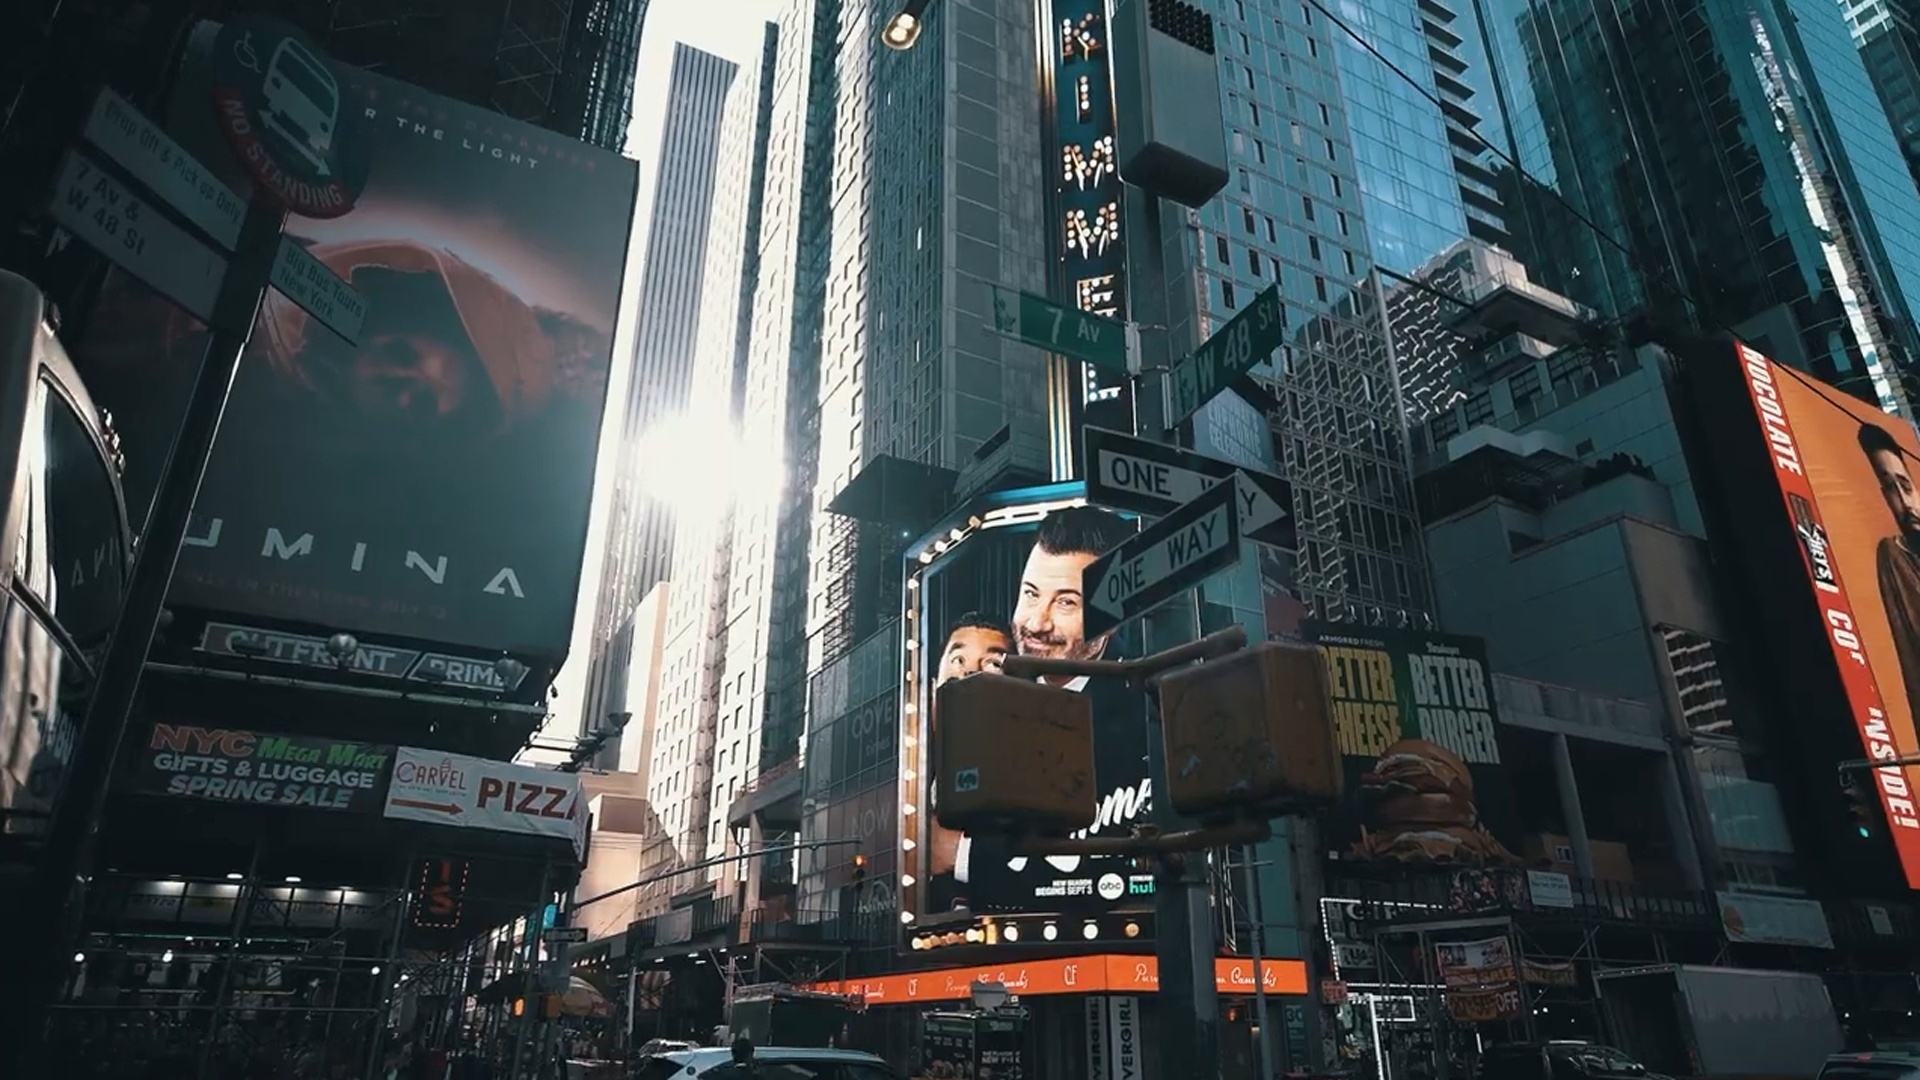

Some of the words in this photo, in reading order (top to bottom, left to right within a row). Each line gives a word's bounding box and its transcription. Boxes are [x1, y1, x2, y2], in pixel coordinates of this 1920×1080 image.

[222, 98, 251, 135] NO
[246, 143, 344, 208] STANDING
[396, 116, 445, 141] THE
[461, 137, 539, 169] LIGHT
[76, 163, 90, 180] 7
[93, 179, 120, 204] Av
[125, 202, 140, 222] &
[172, 156, 197, 186] Pick
[199, 183, 214, 201] up
[216, 192, 241, 223] Only
[67, 185, 90, 213] W
[93, 206, 119, 235] 48
[123, 226, 145, 256] St
[279, 267, 308, 300] New
[309, 286, 336, 321] York
[286, 245, 305, 275] Big
[307, 260, 331, 292] Bus
[332, 282, 364, 321] Tours
[1044, 307, 1063, 345] 7
[1077, 319, 1101, 343] Av
[1198, 347, 1216, 387] W
[1222, 318, 1252, 371] 48
[1257, 299, 1275, 332] St
[1740, 344, 1803, 477] HOCOLATE
[1111, 457, 1172, 497] ONE
[183, 517, 526, 599] UMINA
[1107, 556, 1146, 604] ONE
[1167, 512, 1218, 570] WAY
[225, 629, 396, 673] OTFRNT
[1408, 652, 1490, 711] BETTER
[150, 722, 257, 758] NYC
[1417, 706, 1502, 766] BURGER
[153, 753, 229, 775] GIFTS
[234, 759, 253, 778] &
[258, 762, 376, 790] LUGGAGE
[167, 773, 277, 803] SPRING
[279, 783, 355, 809] SALE
[395, 760, 467, 791] CARVEL
[1129, 880, 1157, 895] hul
[1230, 966, 1277, 988] Cannbis
[1495, 990, 1519, 1013] OFF
[1118, 997, 1134, 1080] VERGIRL
